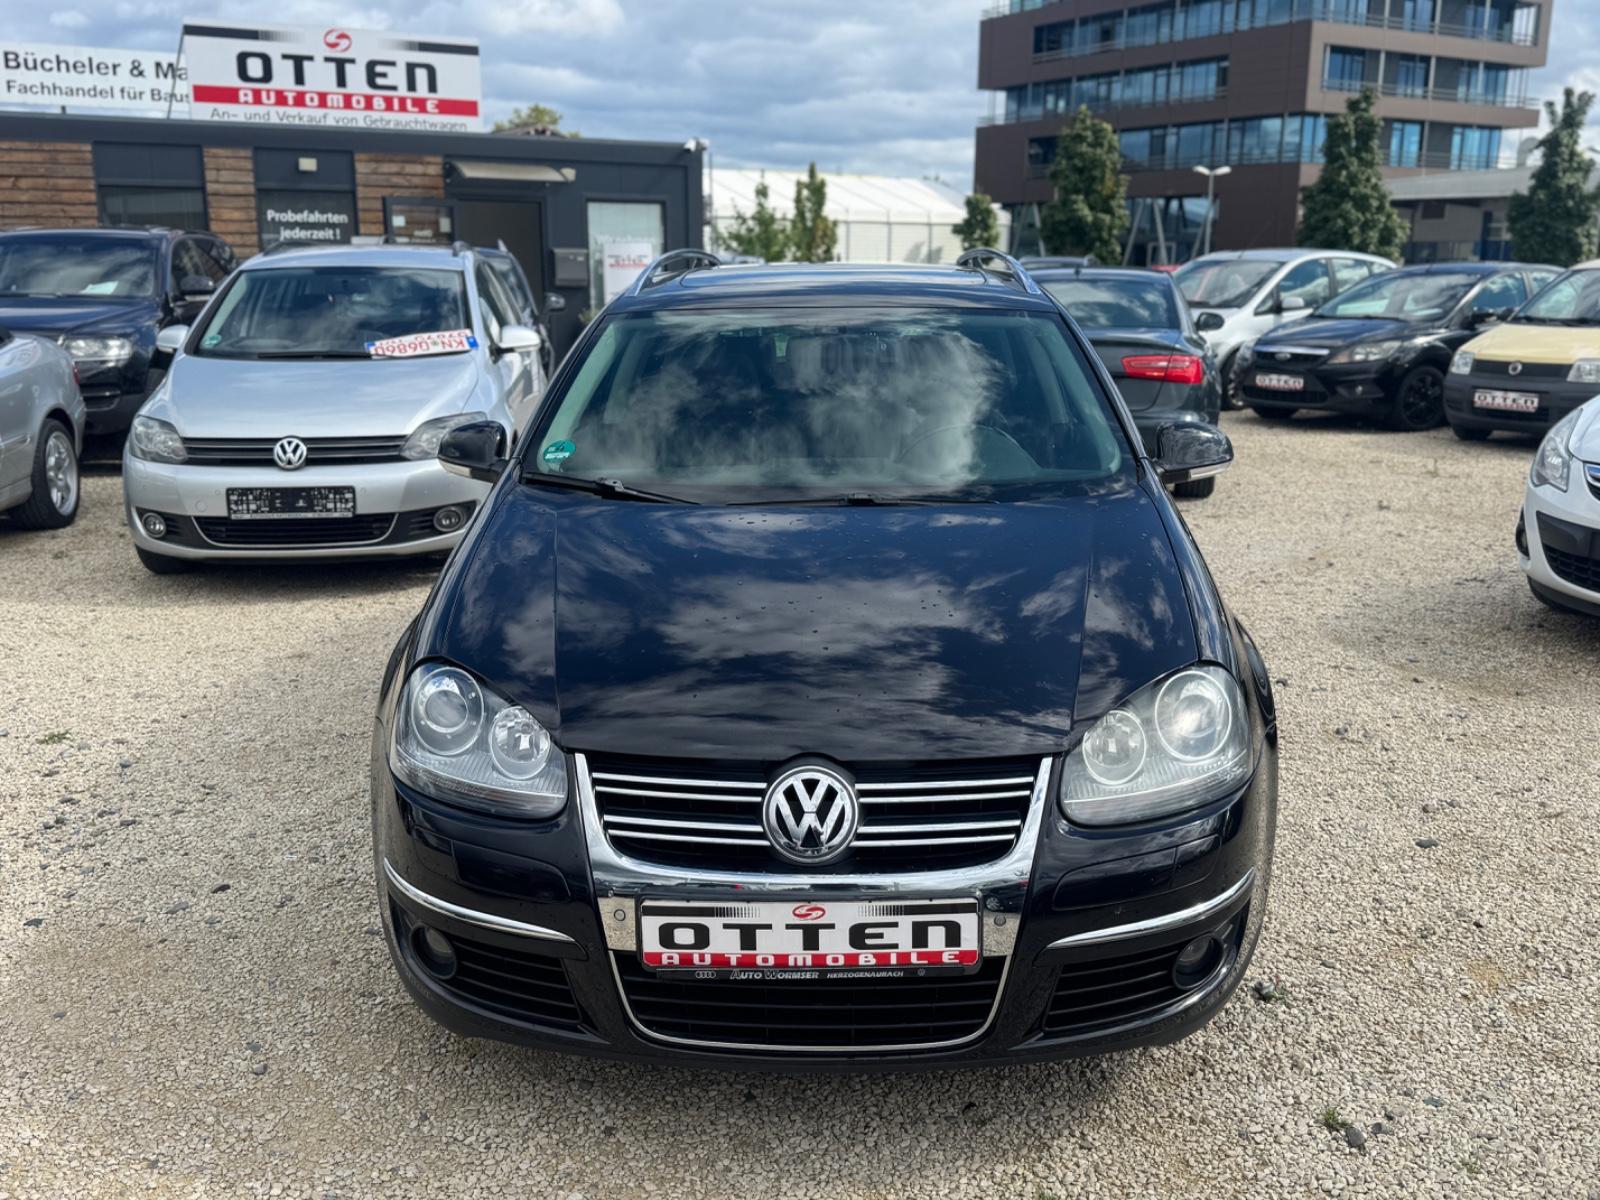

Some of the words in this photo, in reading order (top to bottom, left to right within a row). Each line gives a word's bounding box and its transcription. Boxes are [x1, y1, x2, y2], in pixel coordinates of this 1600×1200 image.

[3, 51, 121, 77] Bücheler
[129, 59, 146, 78] &
[236, 51, 438, 94] OTTEN
[6, 80, 114, 99] Fachhandel
[119, 86, 145, 101] für
[238, 89, 440, 113] AUTOMOBILE
[210, 107, 239, 120] An-
[243, 109, 271, 122] und
[276, 110, 328, 126] Verkauf
[334, 116, 359, 127] von
[363, 116, 468, 131] Gebrauchtwagen
[266, 209, 349, 224] Probefahrten
[657, 920, 962, 952] OTTEN
[660, 951, 961, 967] AUTOMOBILE
